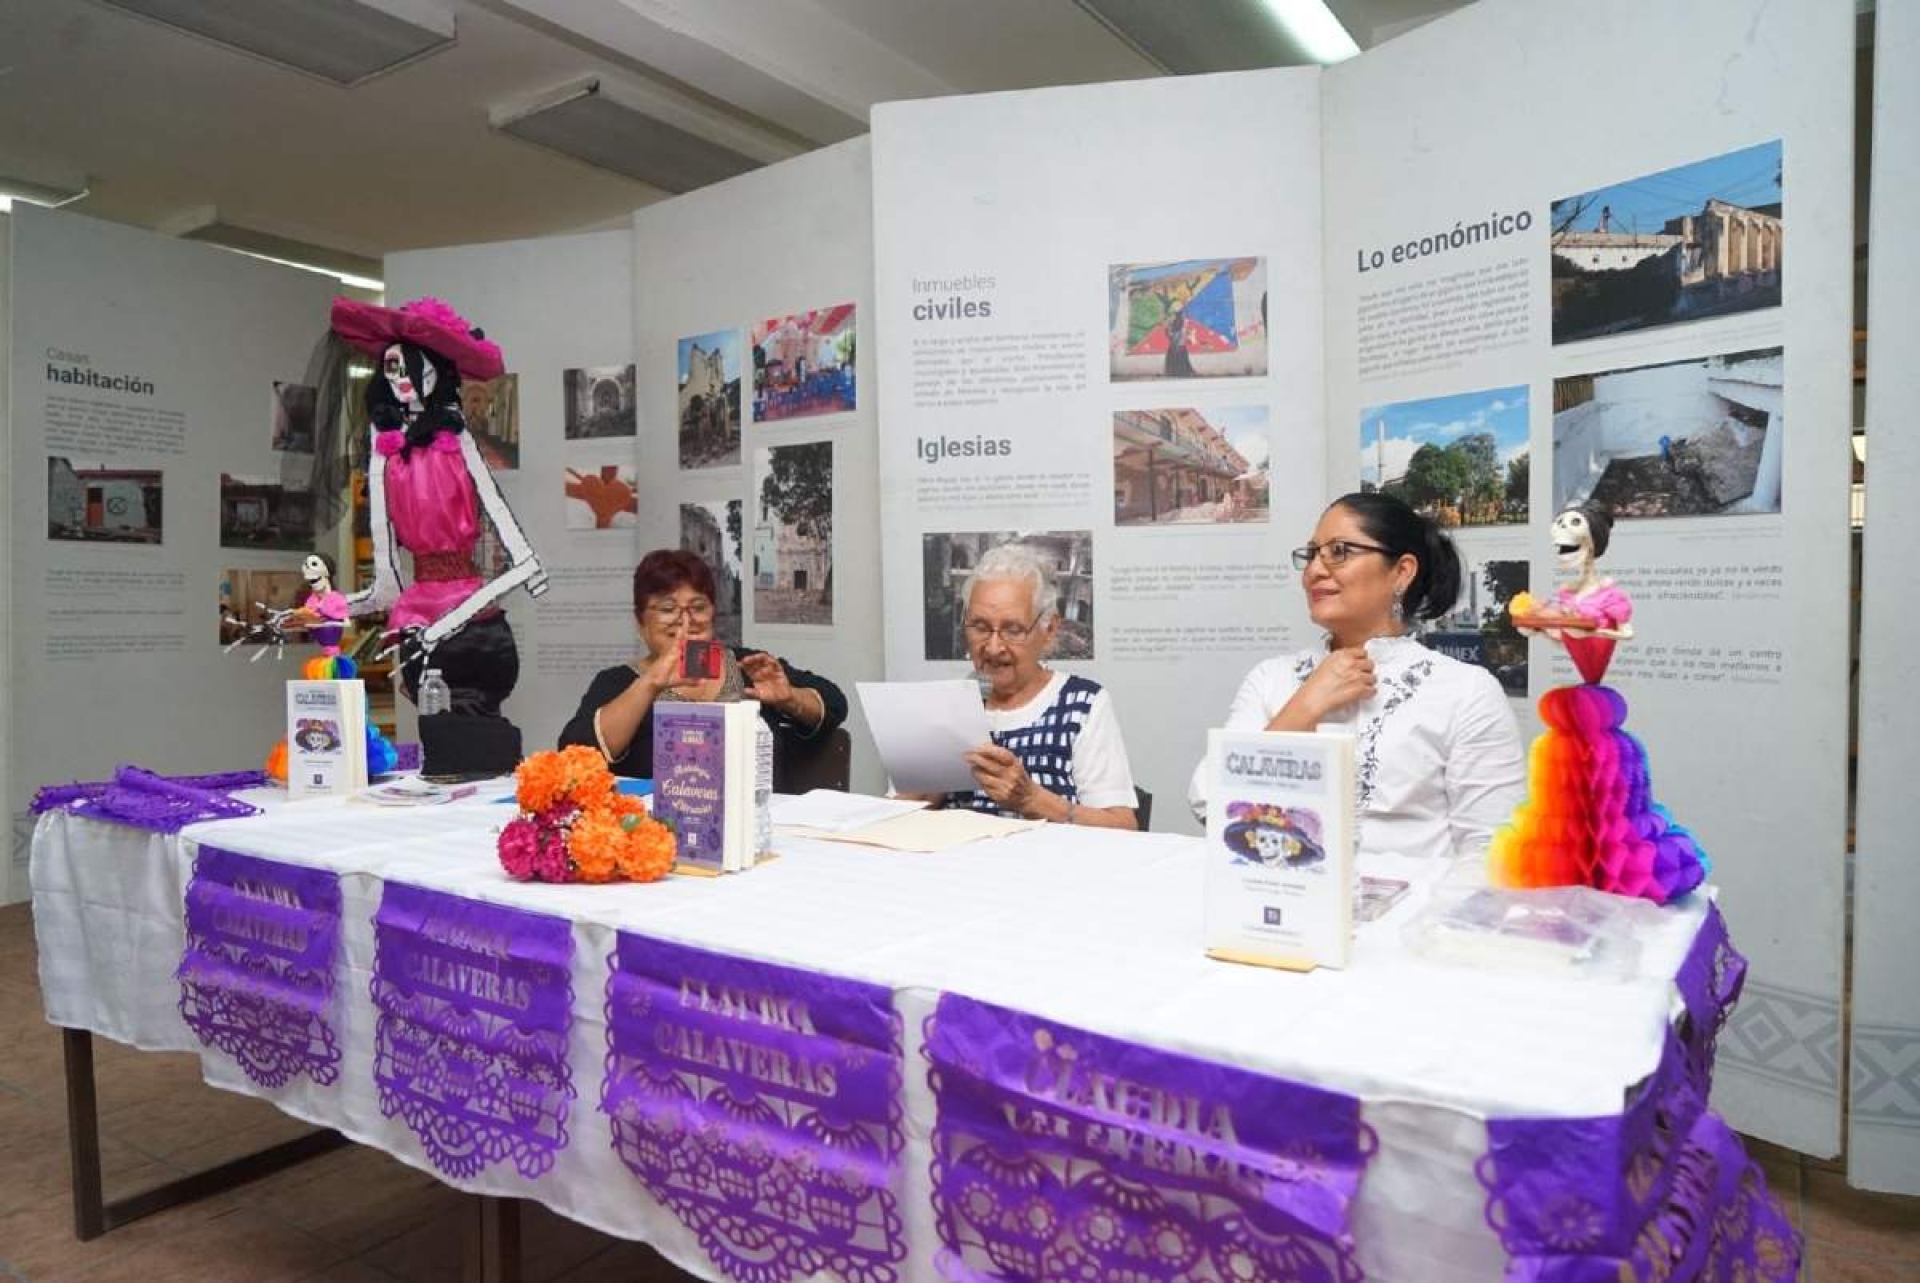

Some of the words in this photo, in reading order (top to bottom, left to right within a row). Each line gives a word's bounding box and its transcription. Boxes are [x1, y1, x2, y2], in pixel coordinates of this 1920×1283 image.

[1357, 249, 1385, 273] Lo
[1391, 210, 1532, 264] económico
[912, 274, 997, 294] Inmuebles
[913, 296, 992, 321] civiles
[47, 362, 155, 396] habitación
[917, 434, 1013, 464] Iglesias
[1226, 752, 1323, 781] CALAVERAS
[661, 778, 719, 801] Calaveras
[654, 1020, 838, 1098] CALAVERAS
